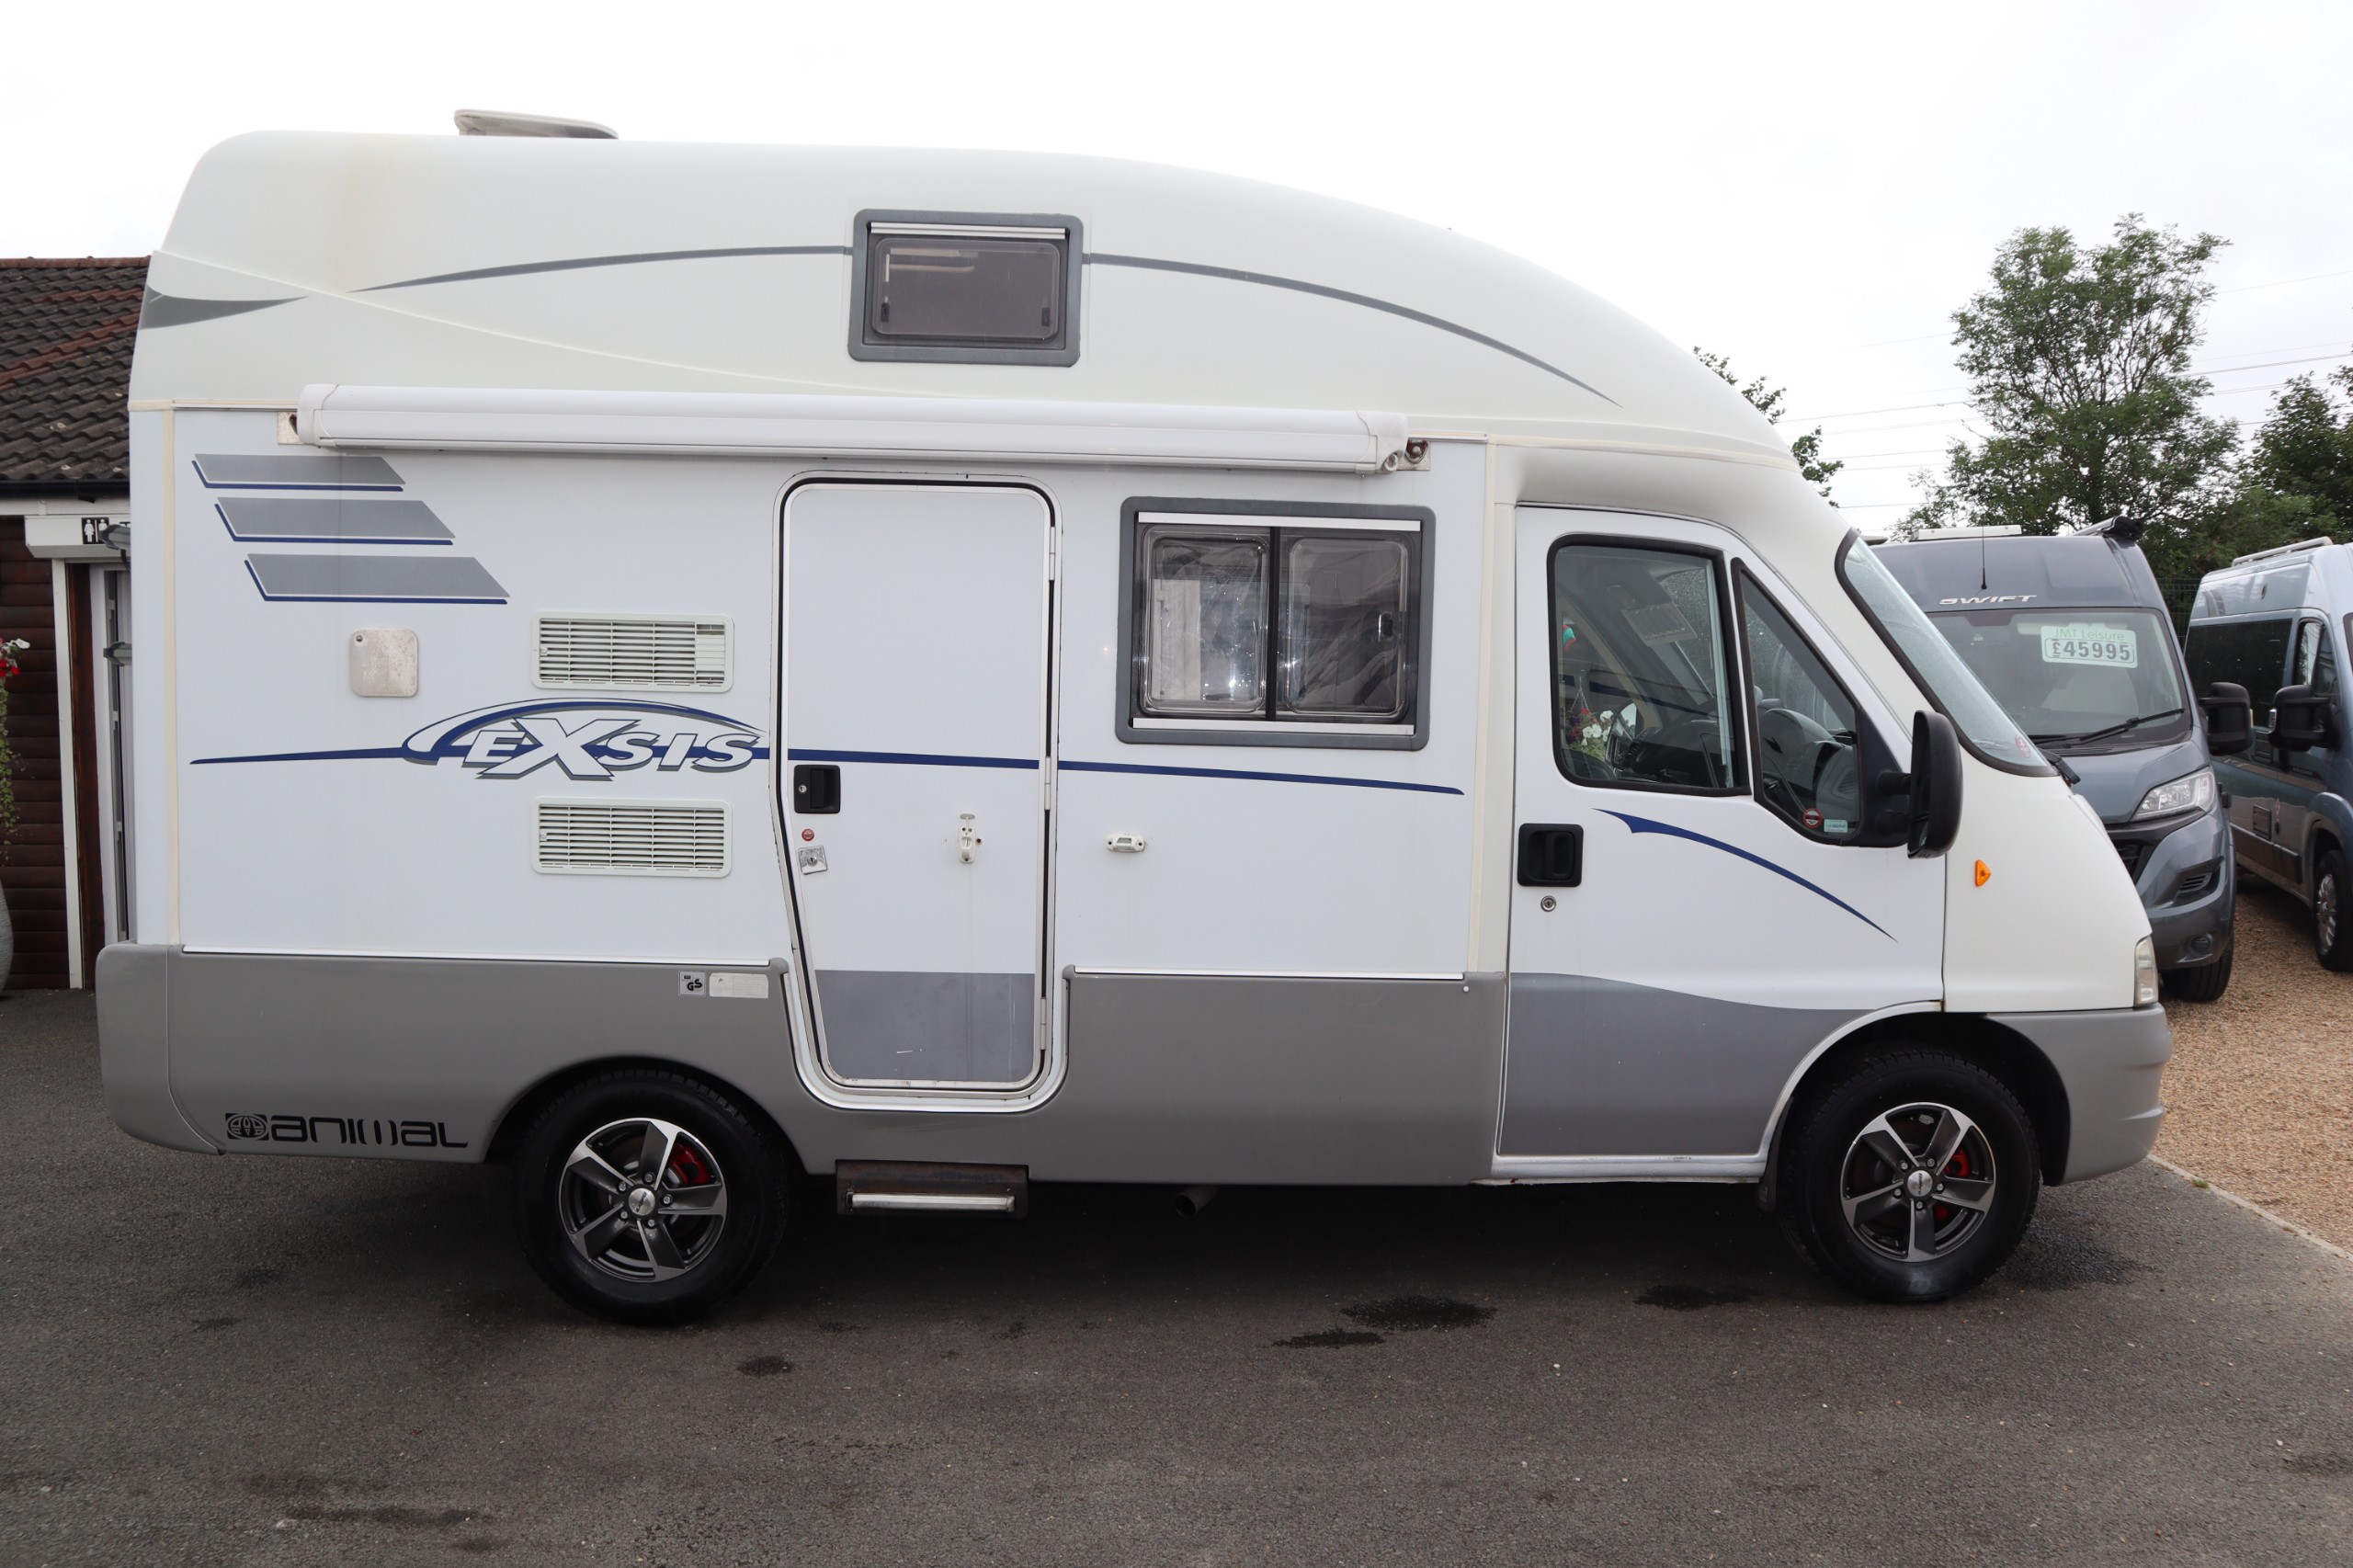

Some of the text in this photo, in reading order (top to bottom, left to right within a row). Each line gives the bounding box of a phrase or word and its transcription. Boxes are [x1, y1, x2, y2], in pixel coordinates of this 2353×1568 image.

[1939, 595, 2037, 605] SWIFT
[2054, 628, 2125, 641] JMT Leisure
[2051, 639, 2131, 661] £45995
